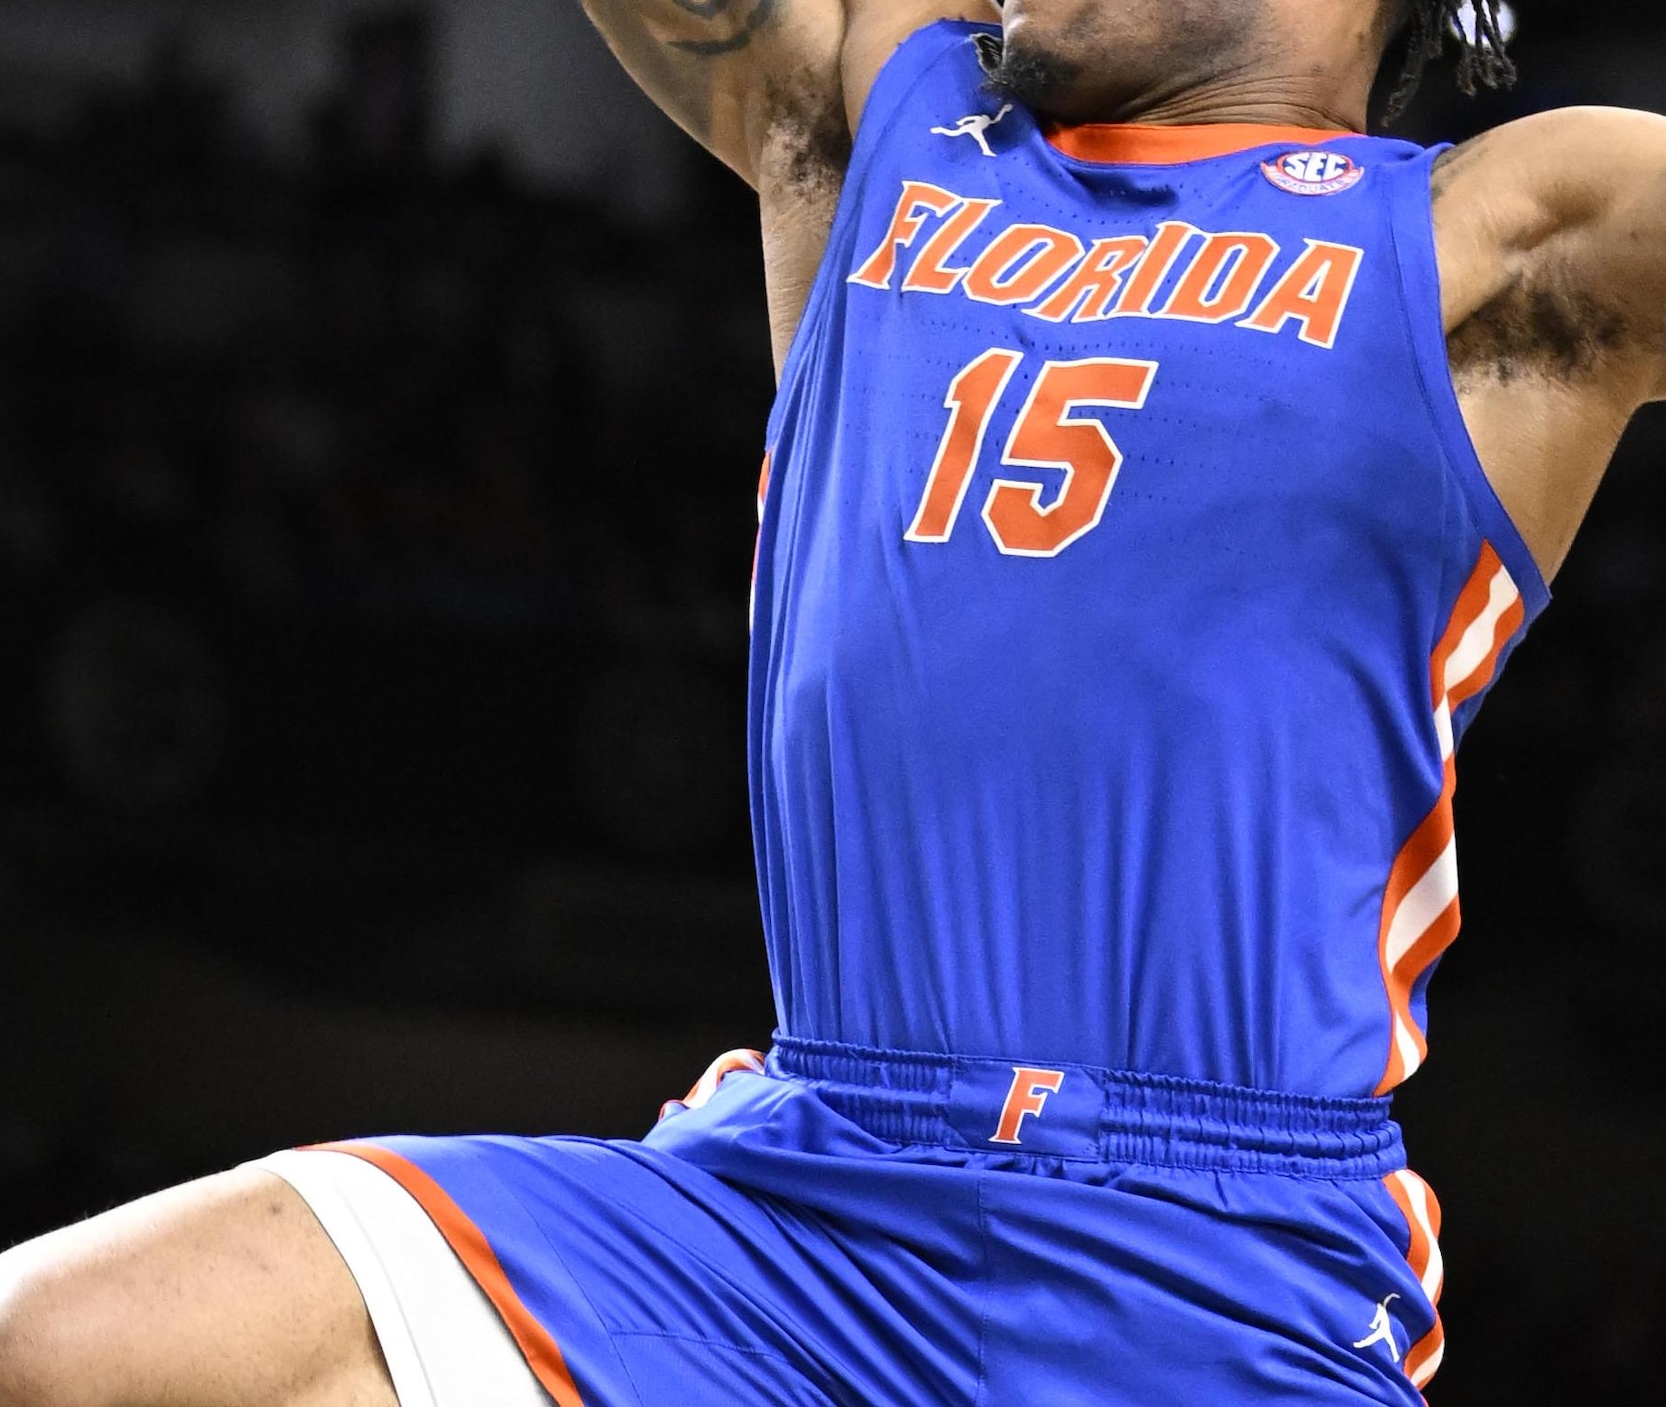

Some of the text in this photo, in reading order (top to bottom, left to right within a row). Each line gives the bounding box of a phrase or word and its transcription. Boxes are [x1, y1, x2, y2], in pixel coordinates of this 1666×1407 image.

[1283, 151, 1348, 182] SEC
[846, 180, 1364, 350] FLORIDA
[903, 346, 1159, 559] 15
[987, 1066, 1065, 1146] F
